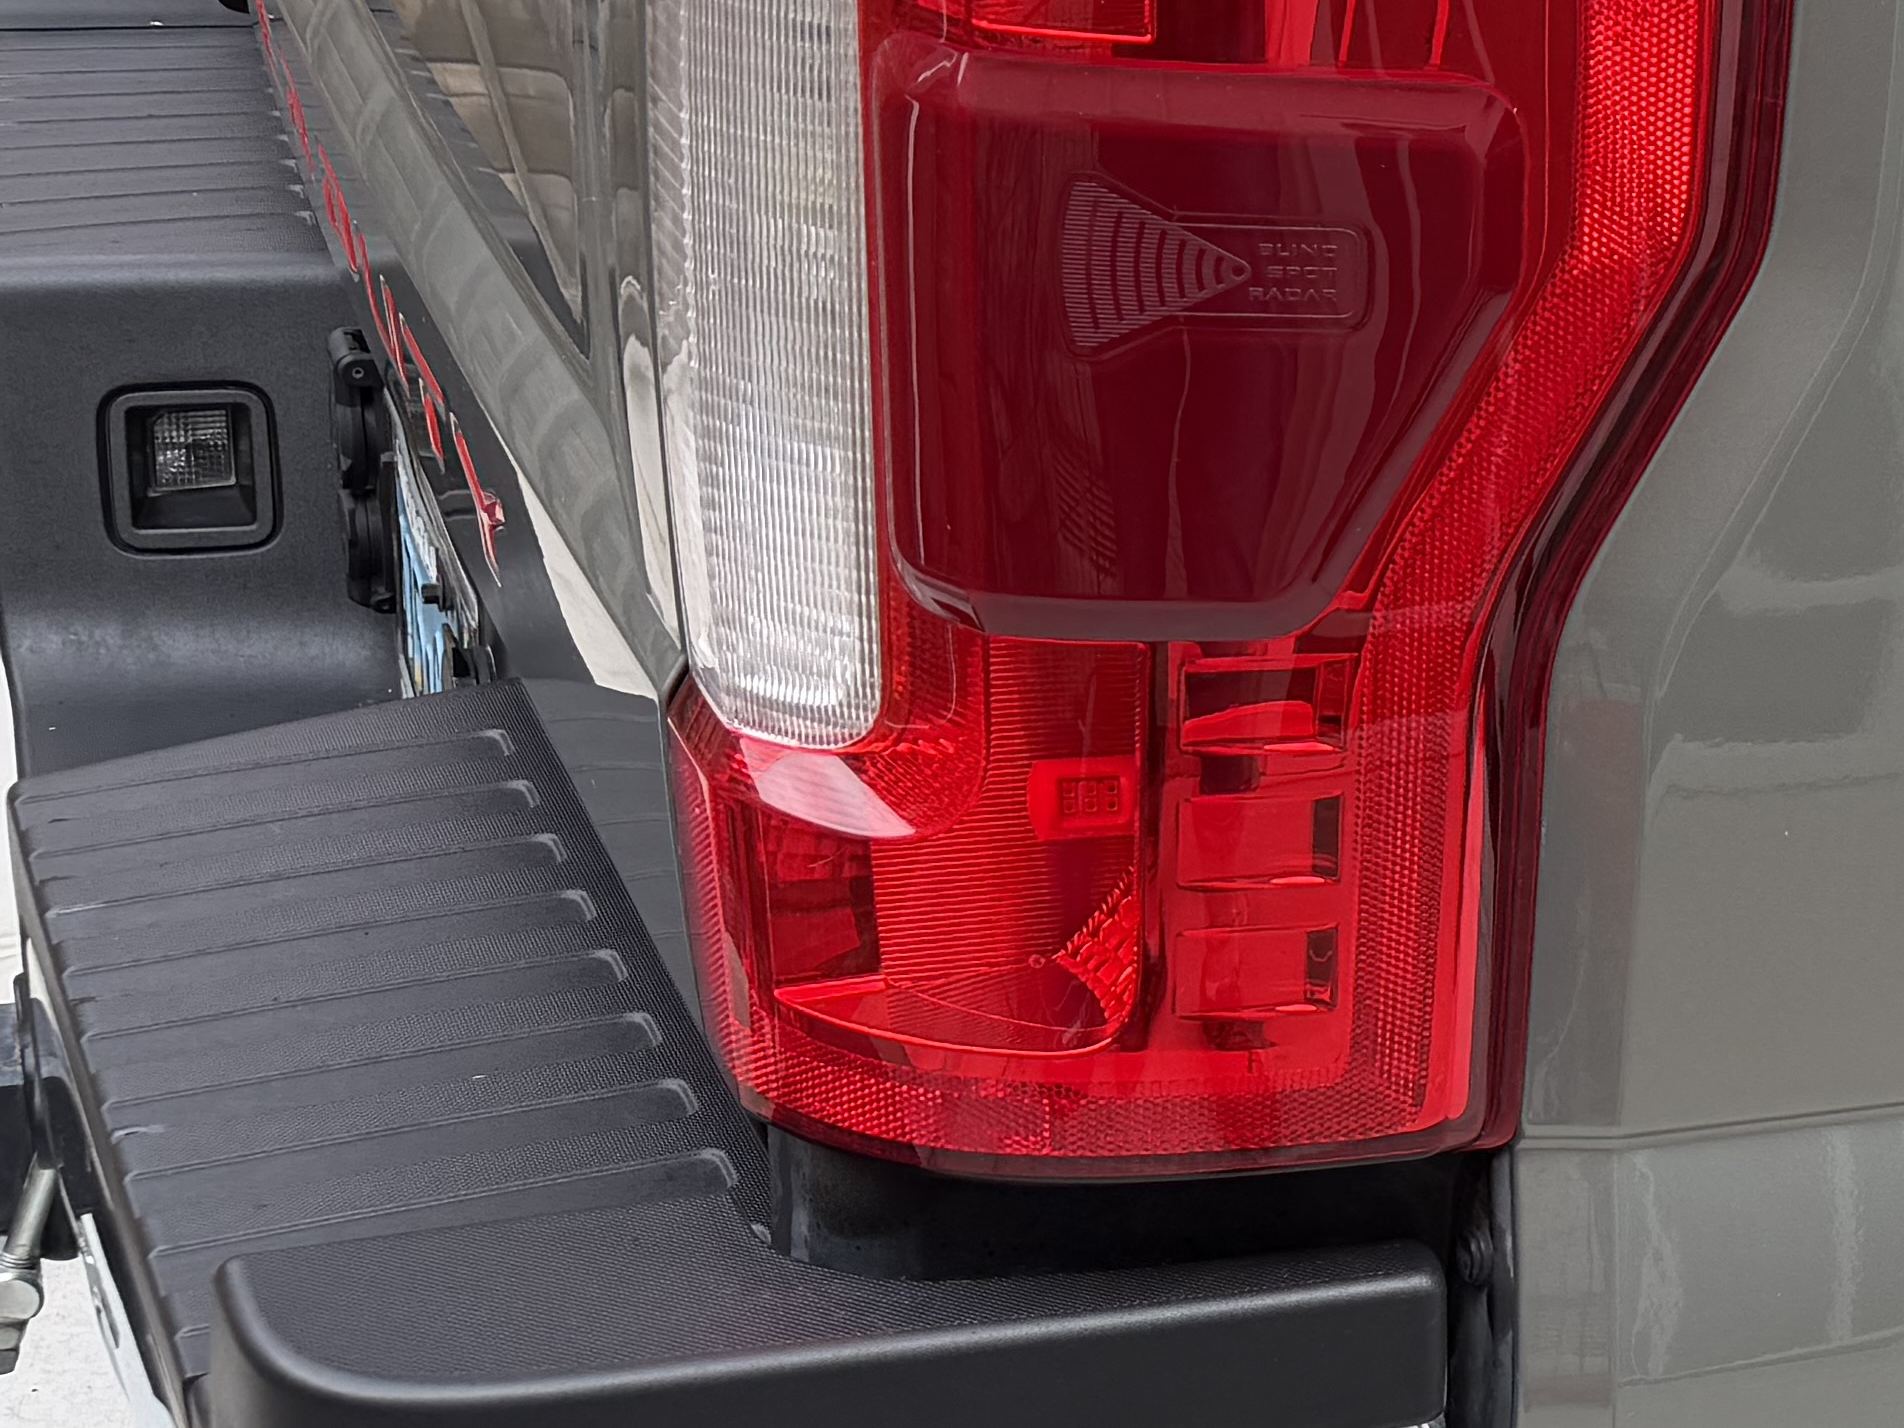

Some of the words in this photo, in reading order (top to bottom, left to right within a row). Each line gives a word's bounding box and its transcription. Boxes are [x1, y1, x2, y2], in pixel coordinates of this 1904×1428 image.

[1257, 242, 1339, 257] BLIND
[1264, 264, 1339, 278] SPOT
[1247, 286, 1338, 302] RADAR
